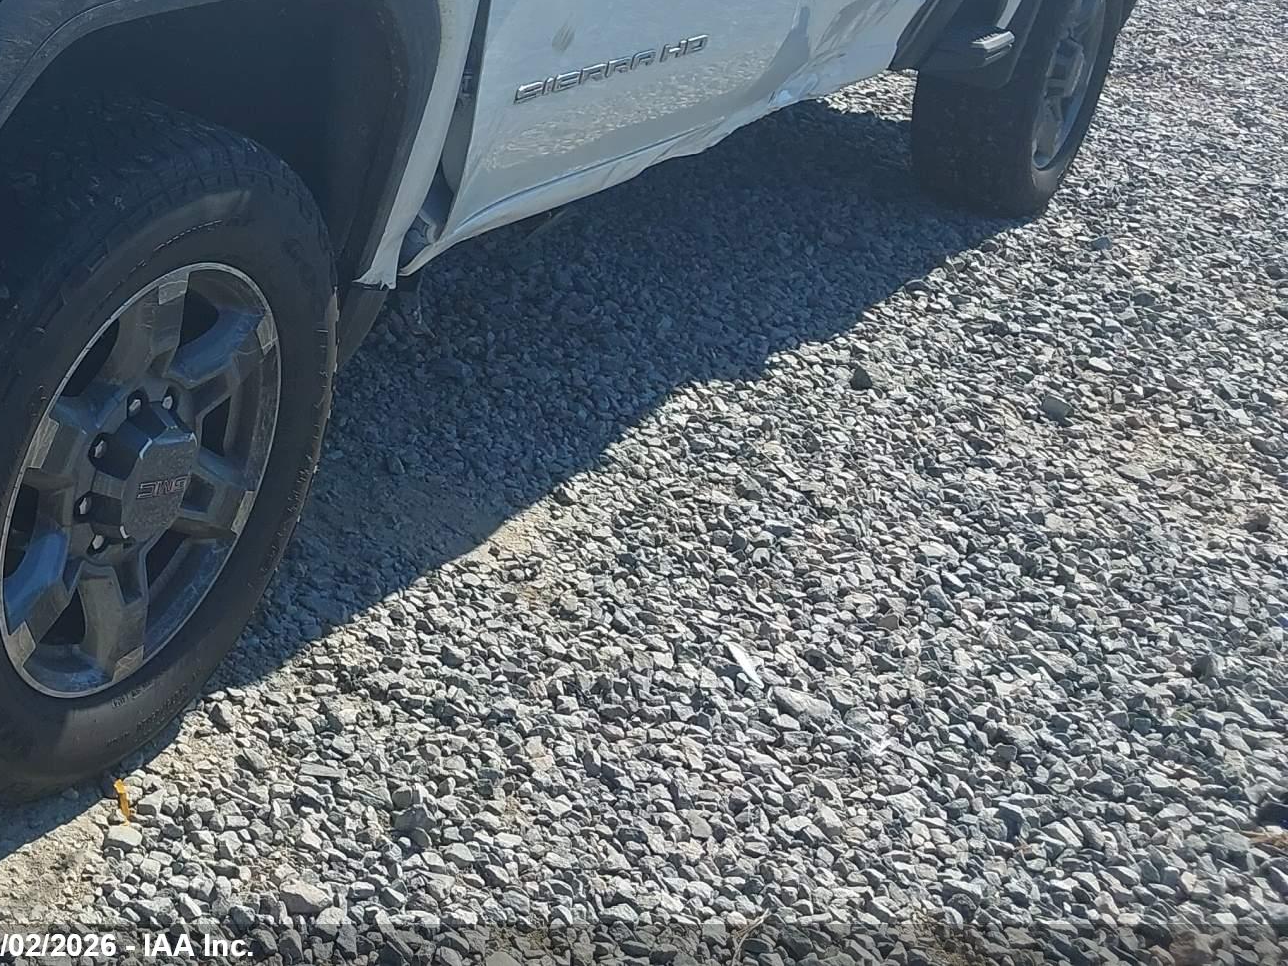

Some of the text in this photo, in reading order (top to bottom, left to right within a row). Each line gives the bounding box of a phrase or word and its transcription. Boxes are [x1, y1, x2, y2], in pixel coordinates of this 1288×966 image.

[513, 34, 709, 104] SIERRA HD
[136, 475, 192, 500] GMC
